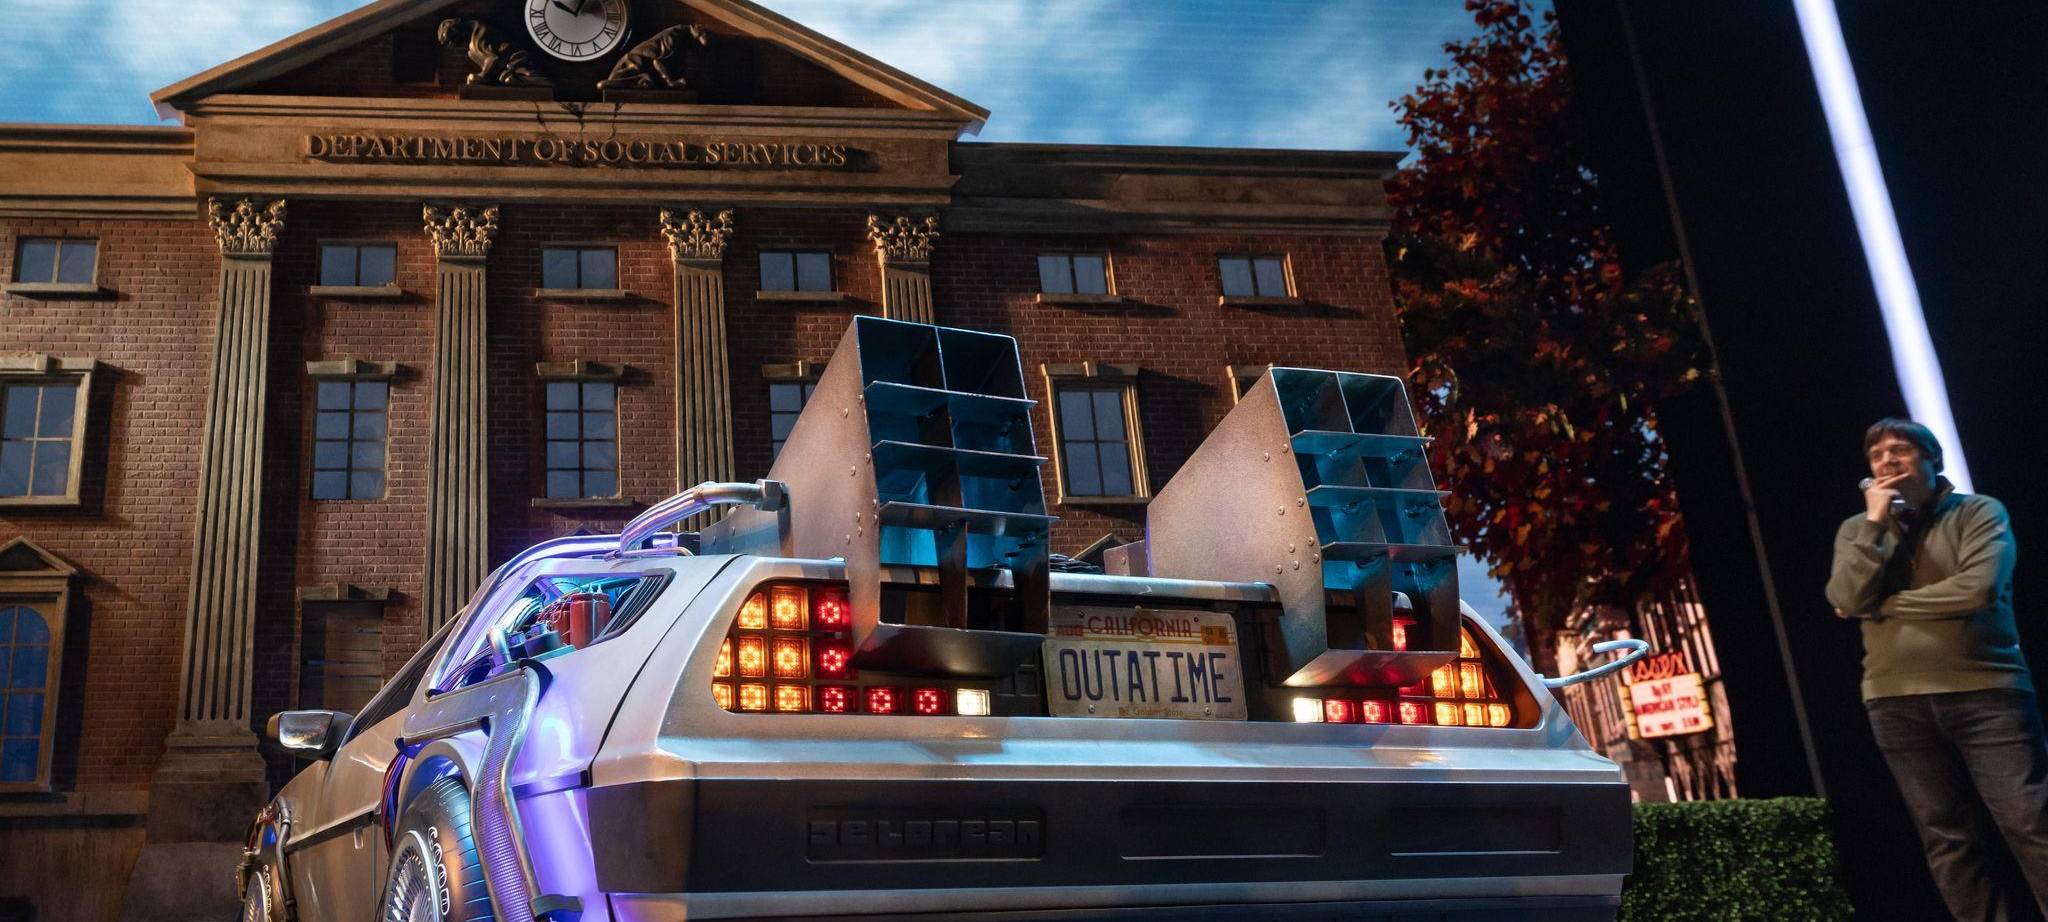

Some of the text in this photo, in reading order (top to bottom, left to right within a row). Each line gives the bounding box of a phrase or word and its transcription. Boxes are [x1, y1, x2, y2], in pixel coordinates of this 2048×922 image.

[303, 134, 848, 166] DEPARTMENT OF SOCIAL SERVICES
[1089, 615, 1193, 638] CALIFORNIA
[1060, 649, 1231, 702] OUTATIME
